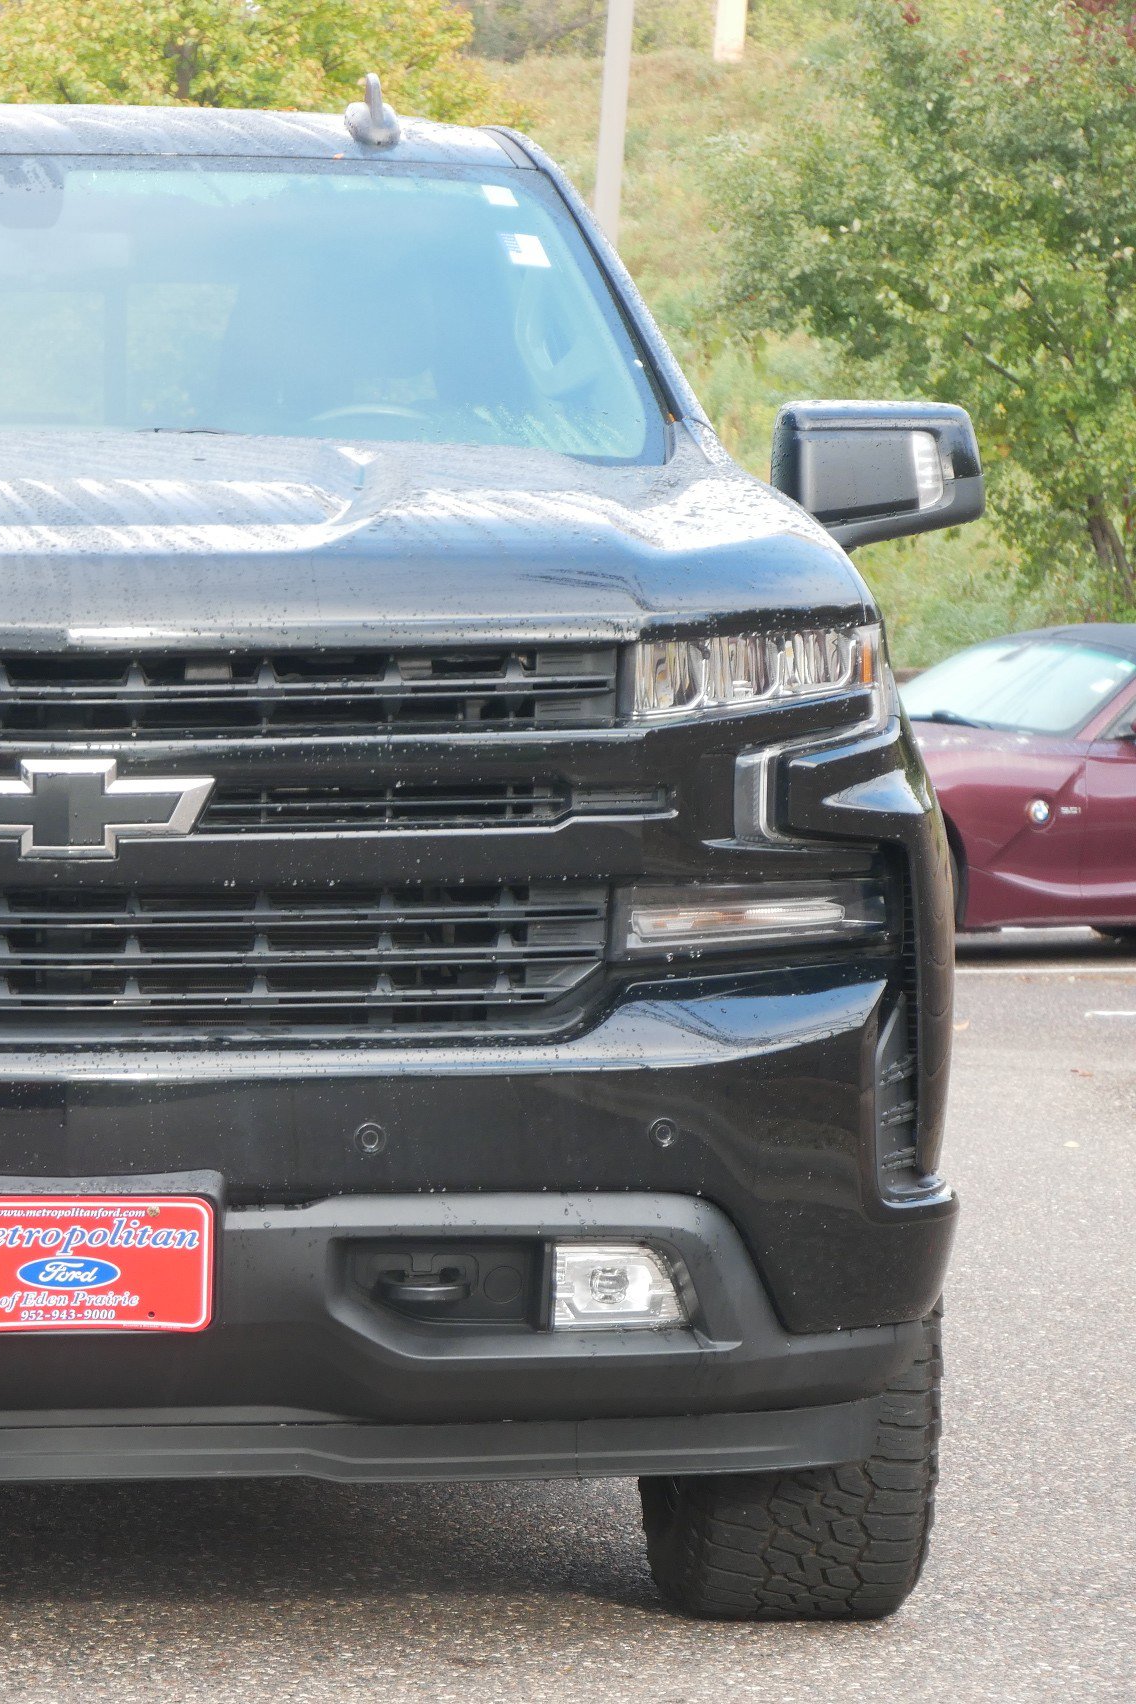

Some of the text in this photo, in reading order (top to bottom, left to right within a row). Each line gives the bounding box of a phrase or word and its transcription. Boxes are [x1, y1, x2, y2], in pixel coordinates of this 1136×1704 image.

[37, 1261, 98, 1283] Ford
[21, 1291, 72, 1307] Eden
[72, 1291, 139, 1307] Prairie
[20, 1309, 116, 1321] 952-943-9000
